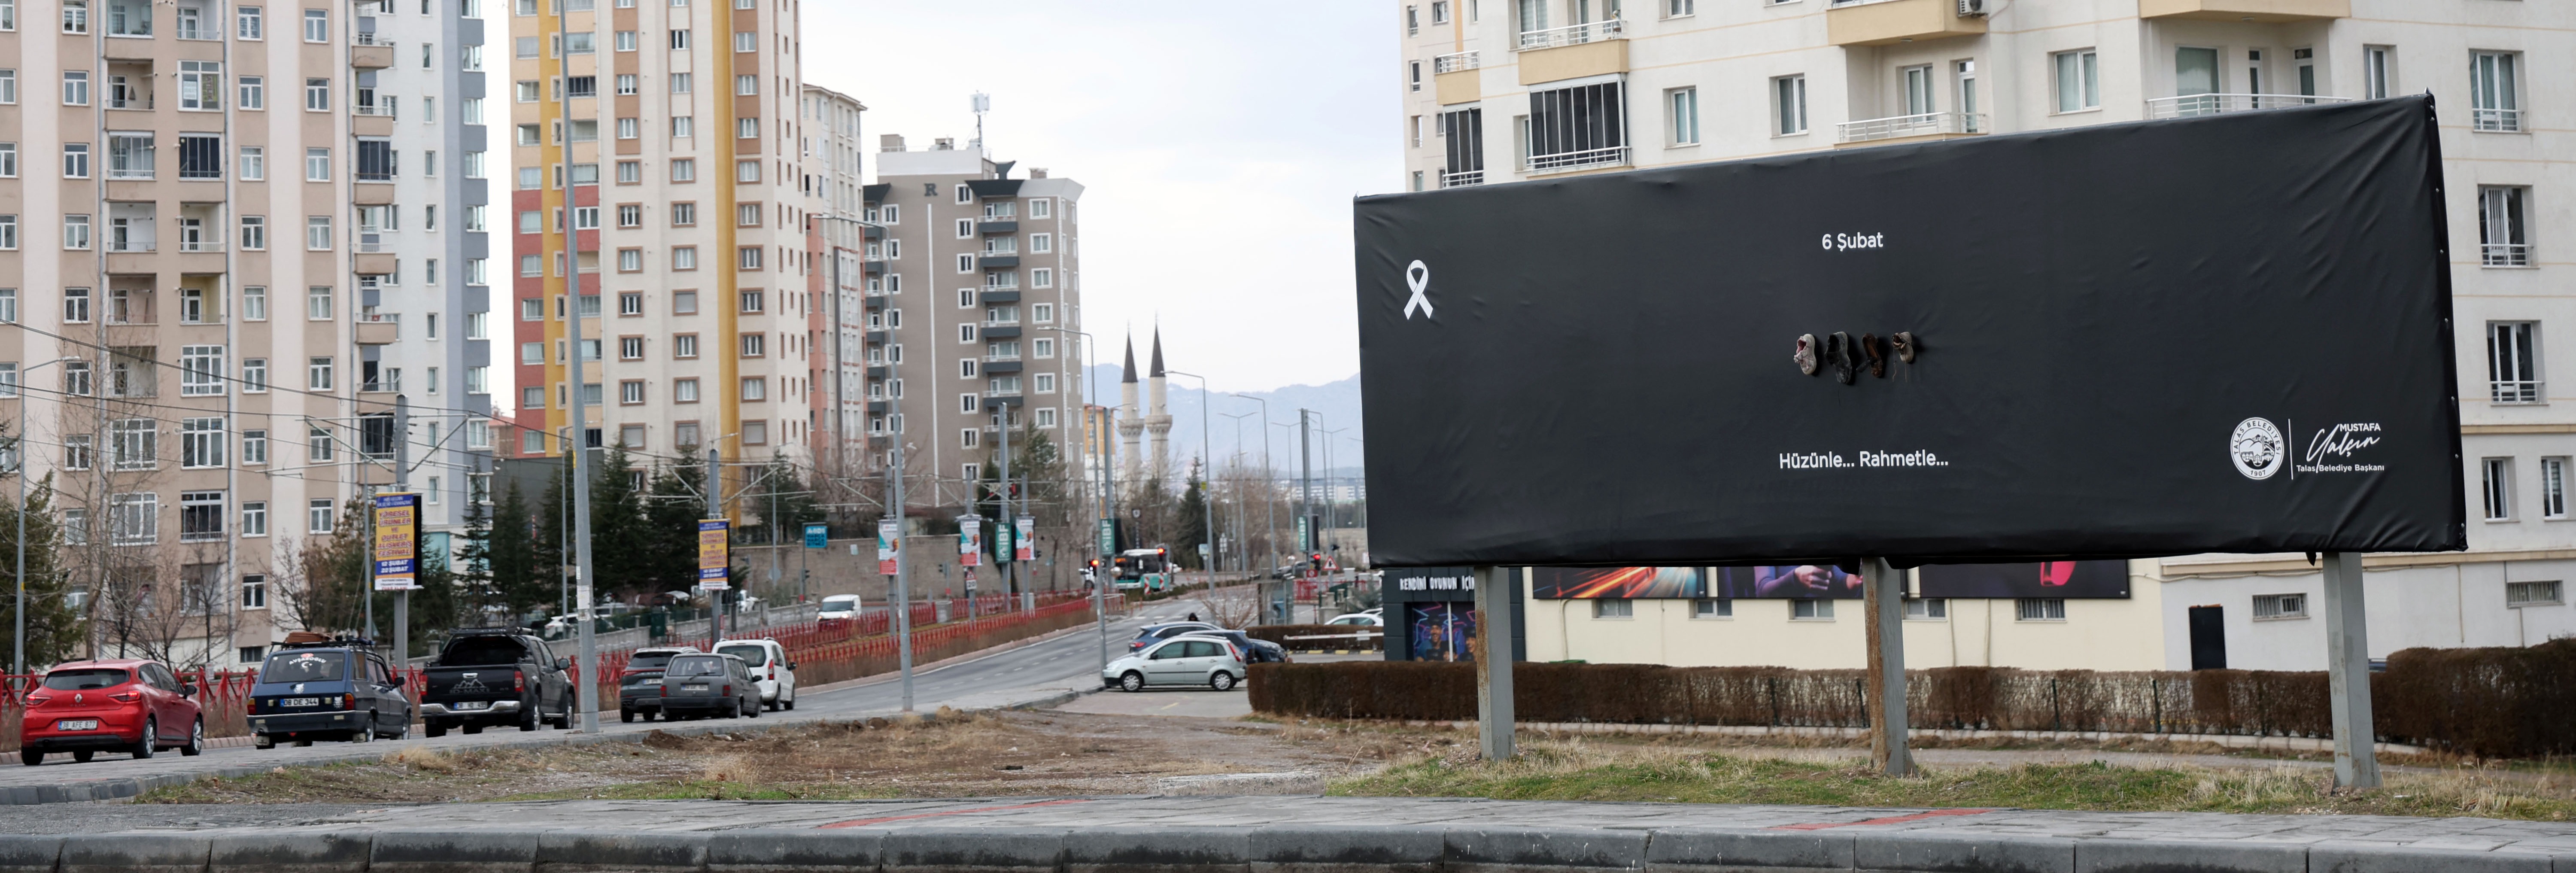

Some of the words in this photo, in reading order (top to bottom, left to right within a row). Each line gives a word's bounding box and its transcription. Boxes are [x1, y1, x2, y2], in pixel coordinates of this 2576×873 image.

[924, 183, 938, 197] R
[1822, 234, 1832, 249] 6
[1837, 232, 1883, 252] Şubat
[2340, 423, 2381, 432] MUSTAFA
[2234, 427, 2245, 455] TALAS
[2306, 424, 2380, 474] Yalçın
[1780, 451, 1855, 469] Hüzünle...
[1859, 449, 1949, 467] Rahmetle...
[2319, 464, 2352, 472] Belediye
[2354, 464, 2385, 472] Başkanı
[1400, 576, 1426, 590] KENDİNİ
[1430, 577, 1457, 590] OYUNUN
